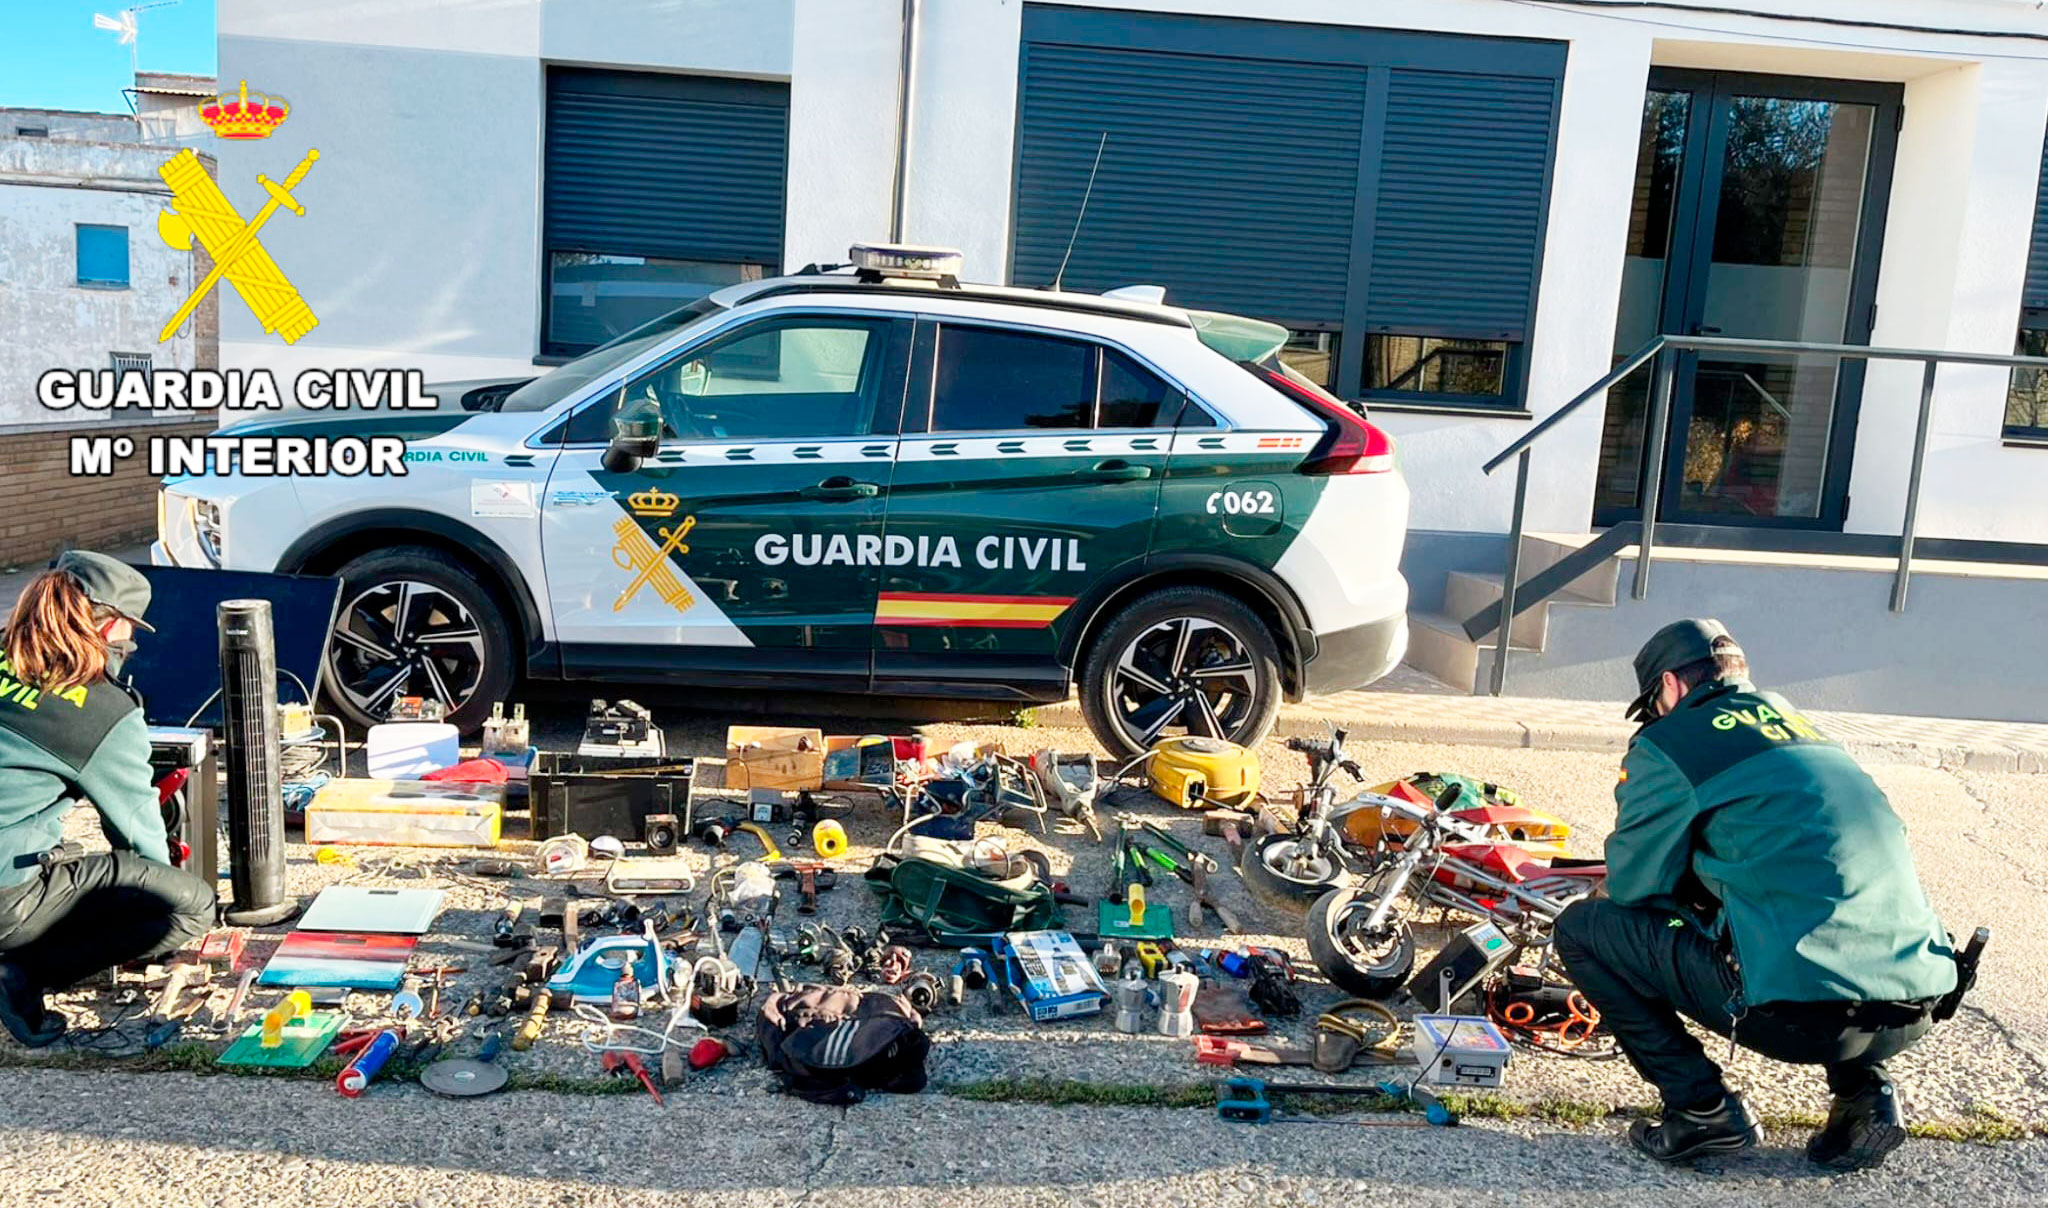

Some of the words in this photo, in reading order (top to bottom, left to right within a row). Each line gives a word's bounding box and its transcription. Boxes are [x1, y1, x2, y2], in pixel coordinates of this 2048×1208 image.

[404, 451, 442, 462] RDIA
[449, 451, 488, 462] CIVIL
[1224, 490, 1275, 514] 062
[754, 534, 961, 567] GUARDIA
[975, 535, 1086, 571] CIVIL
[0, 677, 39, 710] VIL
